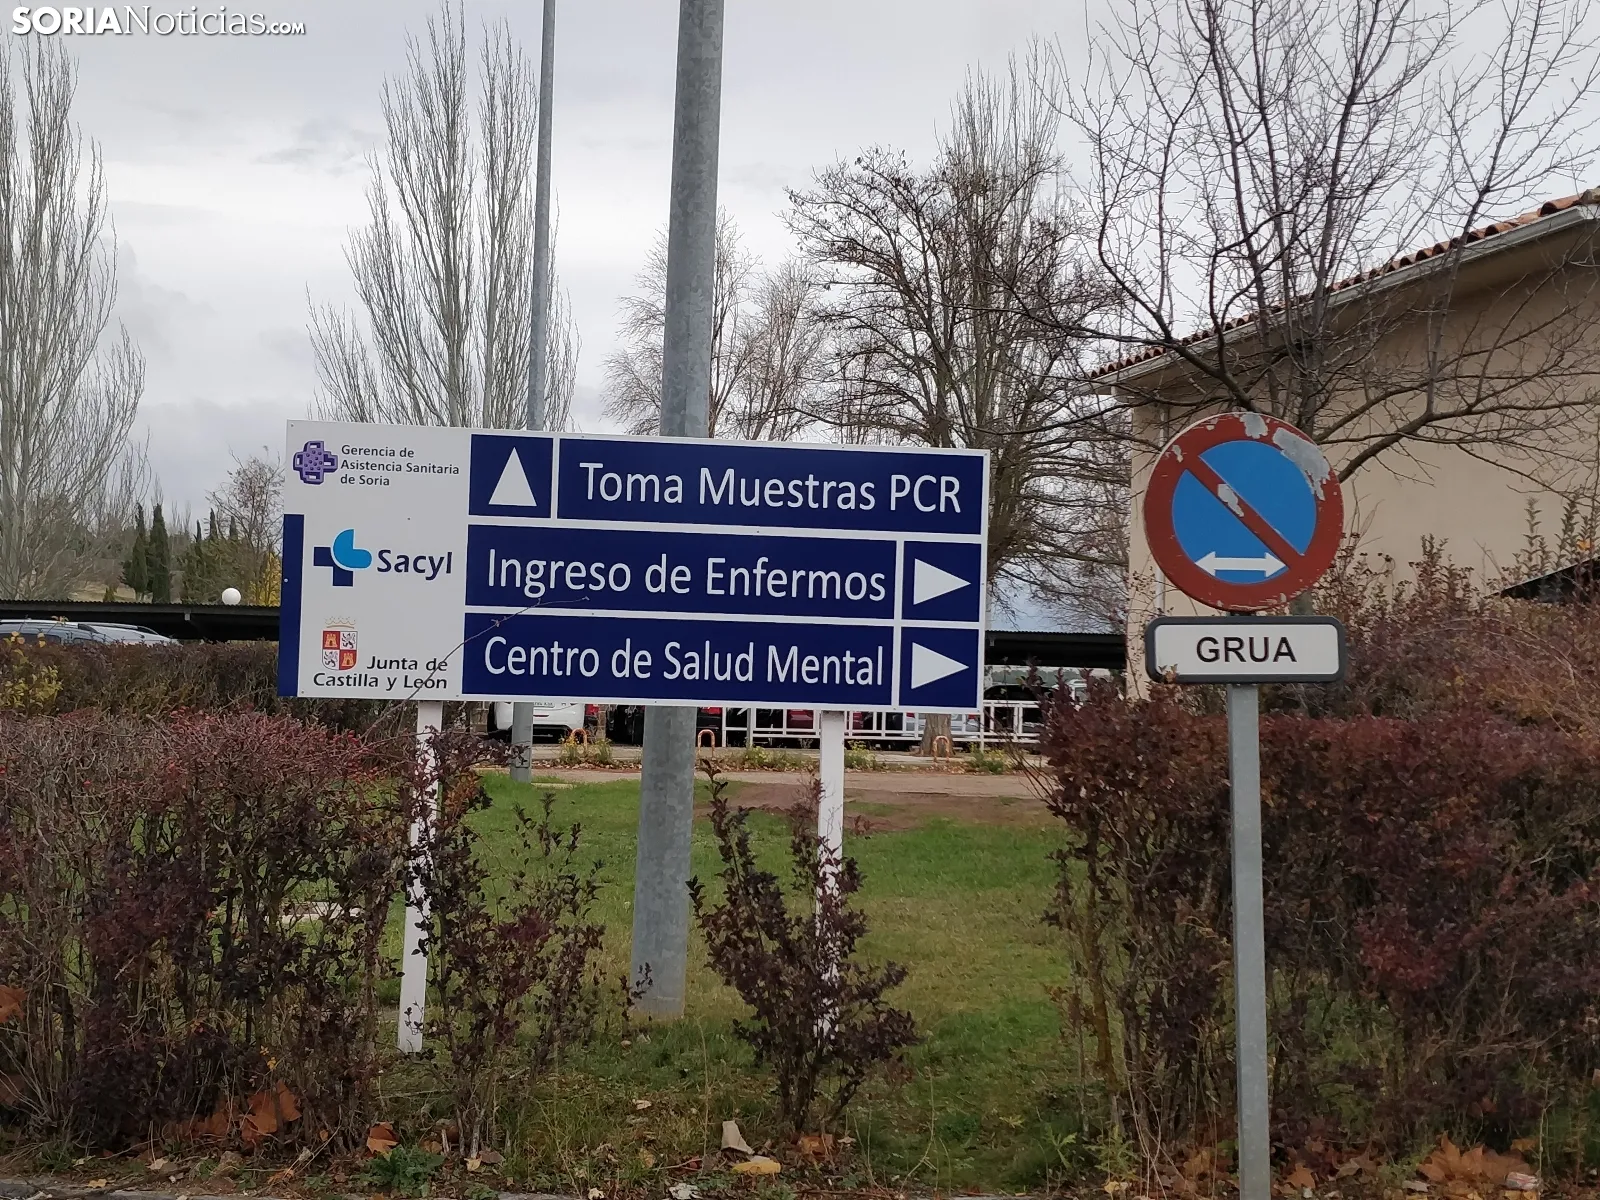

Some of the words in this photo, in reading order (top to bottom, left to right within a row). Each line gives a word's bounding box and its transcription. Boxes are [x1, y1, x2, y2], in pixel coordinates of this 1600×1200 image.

[341, 444, 396, 458] Gerencia
[399, 447, 415, 458] de
[340, 459, 402, 473] Asistencia
[405, 462, 460, 475] Sanitaria
[340, 474, 356, 485] de
[359, 475, 390, 486] Soria
[579, 462, 683, 504] Toma
[699, 467, 876, 511] Muestras
[890, 474, 961, 514] PCR
[376, 549, 453, 581] Sacyl
[488, 548, 631, 598] Ingreso
[644, 553, 692, 594] de
[706, 556, 886, 602] Enfermos
[484, 635, 600, 677] Centro
[611, 637, 652, 679] de
[663, 640, 754, 682] Salud
[767, 645, 883, 686] Mental
[1196, 636, 1298, 663] GRUA
[366, 655, 418, 671] Junta
[425, 657, 448, 671] de
[313, 672, 379, 688] Castilla
[385, 676, 398, 691] y
